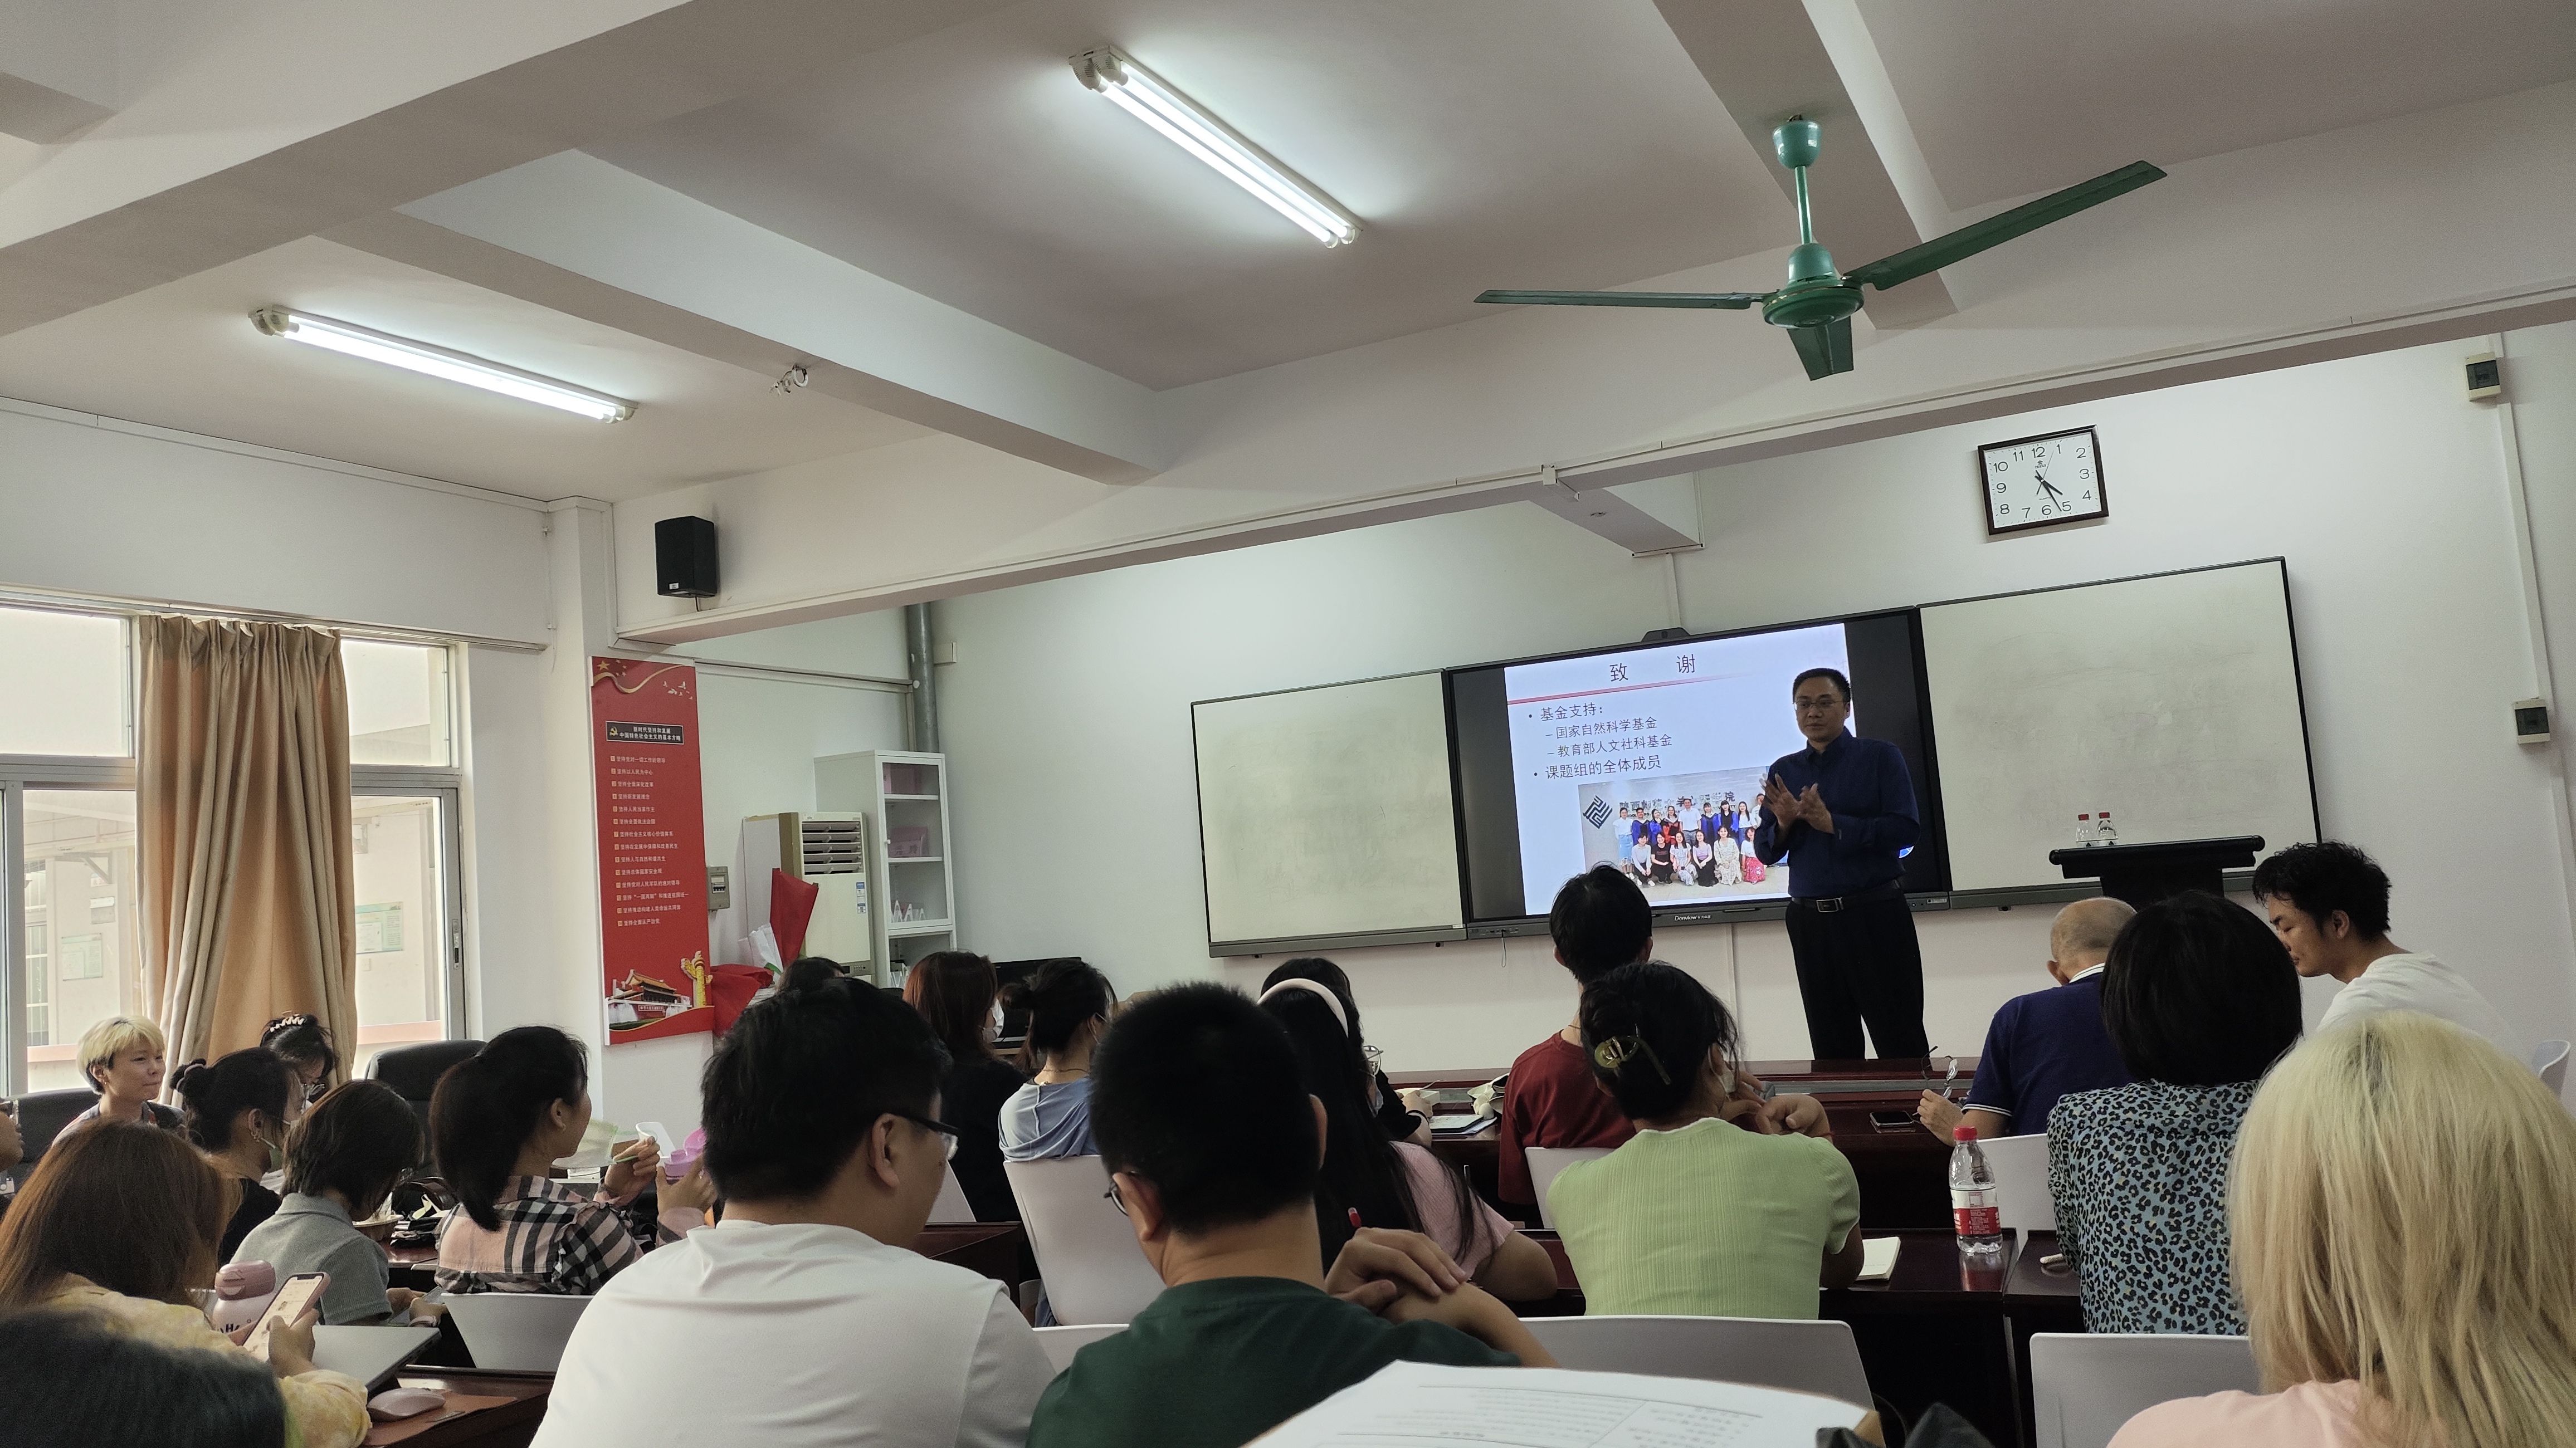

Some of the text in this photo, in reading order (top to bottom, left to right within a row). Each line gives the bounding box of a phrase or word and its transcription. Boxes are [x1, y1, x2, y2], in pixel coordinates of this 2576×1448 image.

[2032, 446, 2046, 458] 12
[2056, 444, 2061, 454] 1
[2076, 447, 2086, 458] 2
[2013, 450, 2024, 462] 11
[1993, 461, 2008, 473] 10
[2080, 468, 2090, 479] 3
[1996, 482, 2006, 493] 9
[2082, 490, 2092, 500] 4
[2000, 503, 2009, 514] 8
[2041, 505, 2052, 516] 6
[2062, 501, 2072, 512] 5
[2022, 507, 2031, 518] 7
[1609, 653, 1696, 682] 致 谢
[1556, 716, 1658, 740] 国家自然科学基金
[619, 732, 681, 741] 中国特色社会主义的基本方略
[1557, 733, 1673, 757] 教育部人文社科基金
[1545, 755, 1662, 780] 课题组的全体成员
